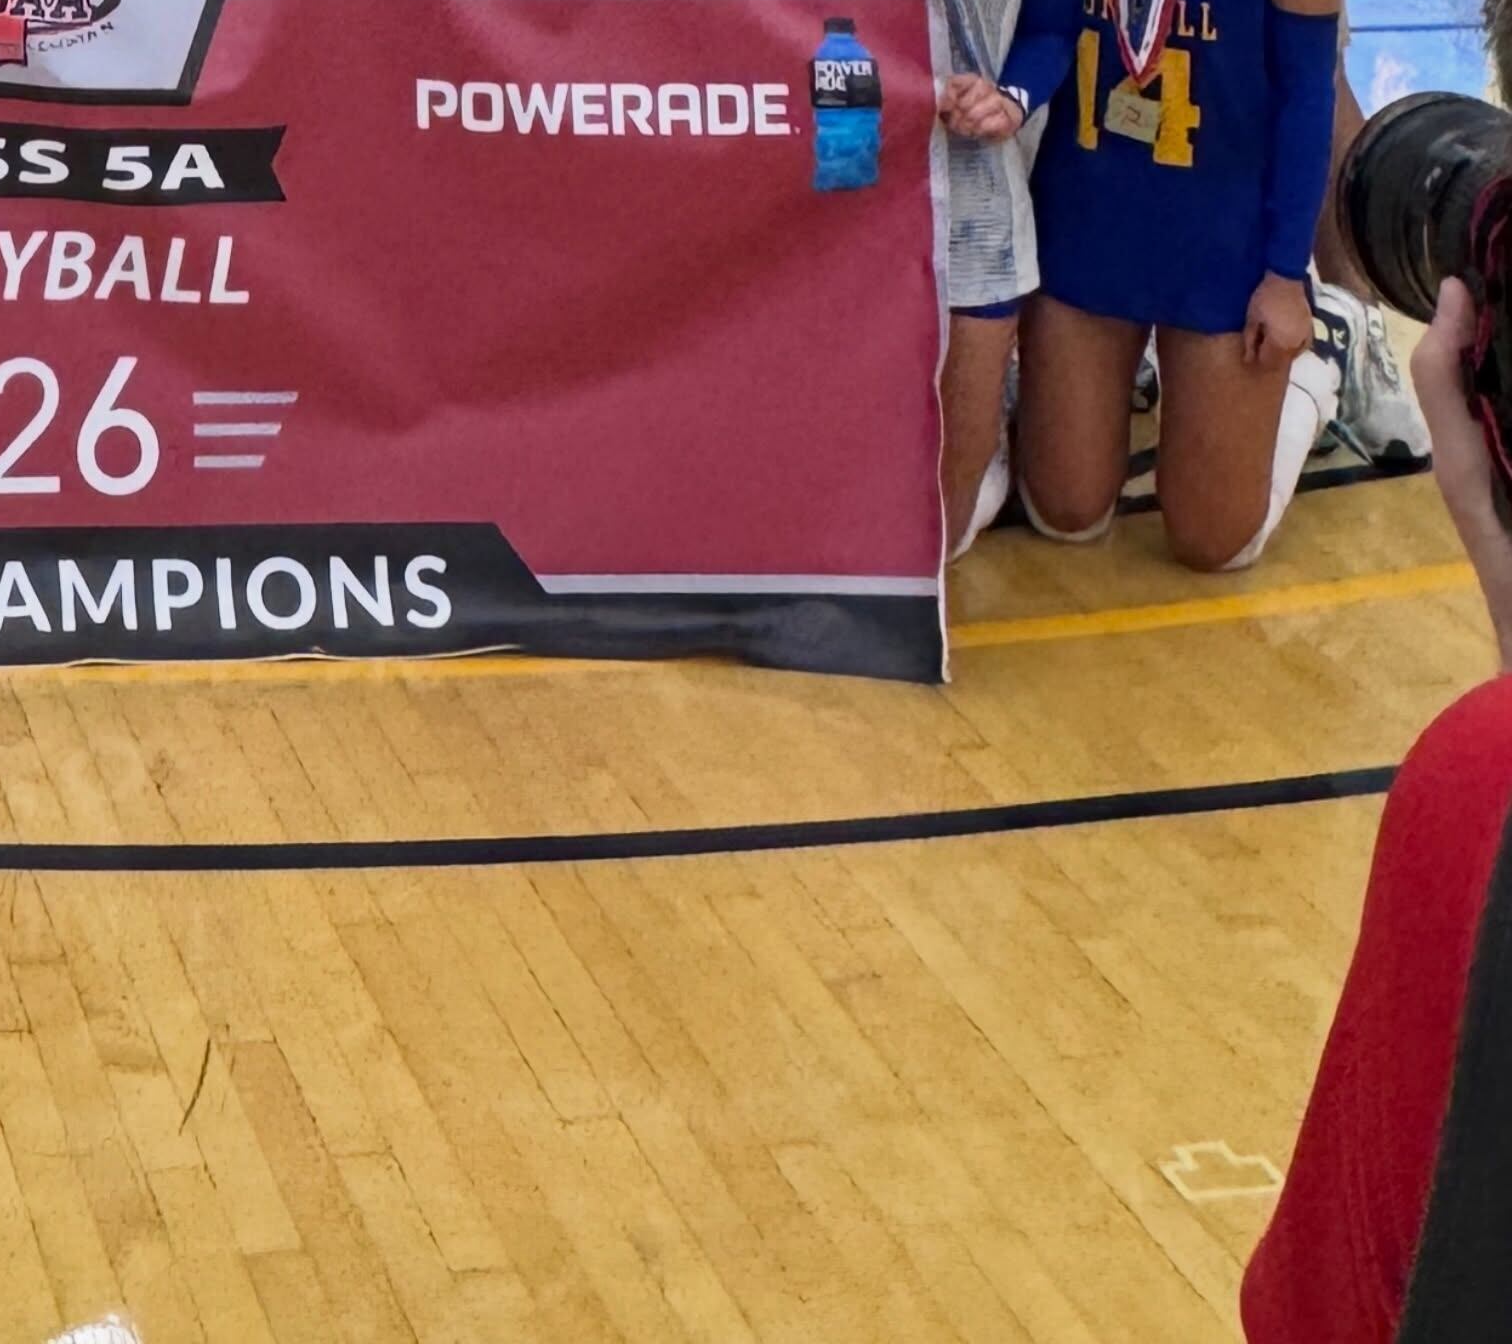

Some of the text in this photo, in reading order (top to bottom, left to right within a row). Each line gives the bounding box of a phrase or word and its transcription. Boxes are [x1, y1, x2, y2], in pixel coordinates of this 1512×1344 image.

[415, 78, 791, 137] POWERADE
[1075, 26, 1201, 169] 14
[102, 143, 225, 191] 5A
